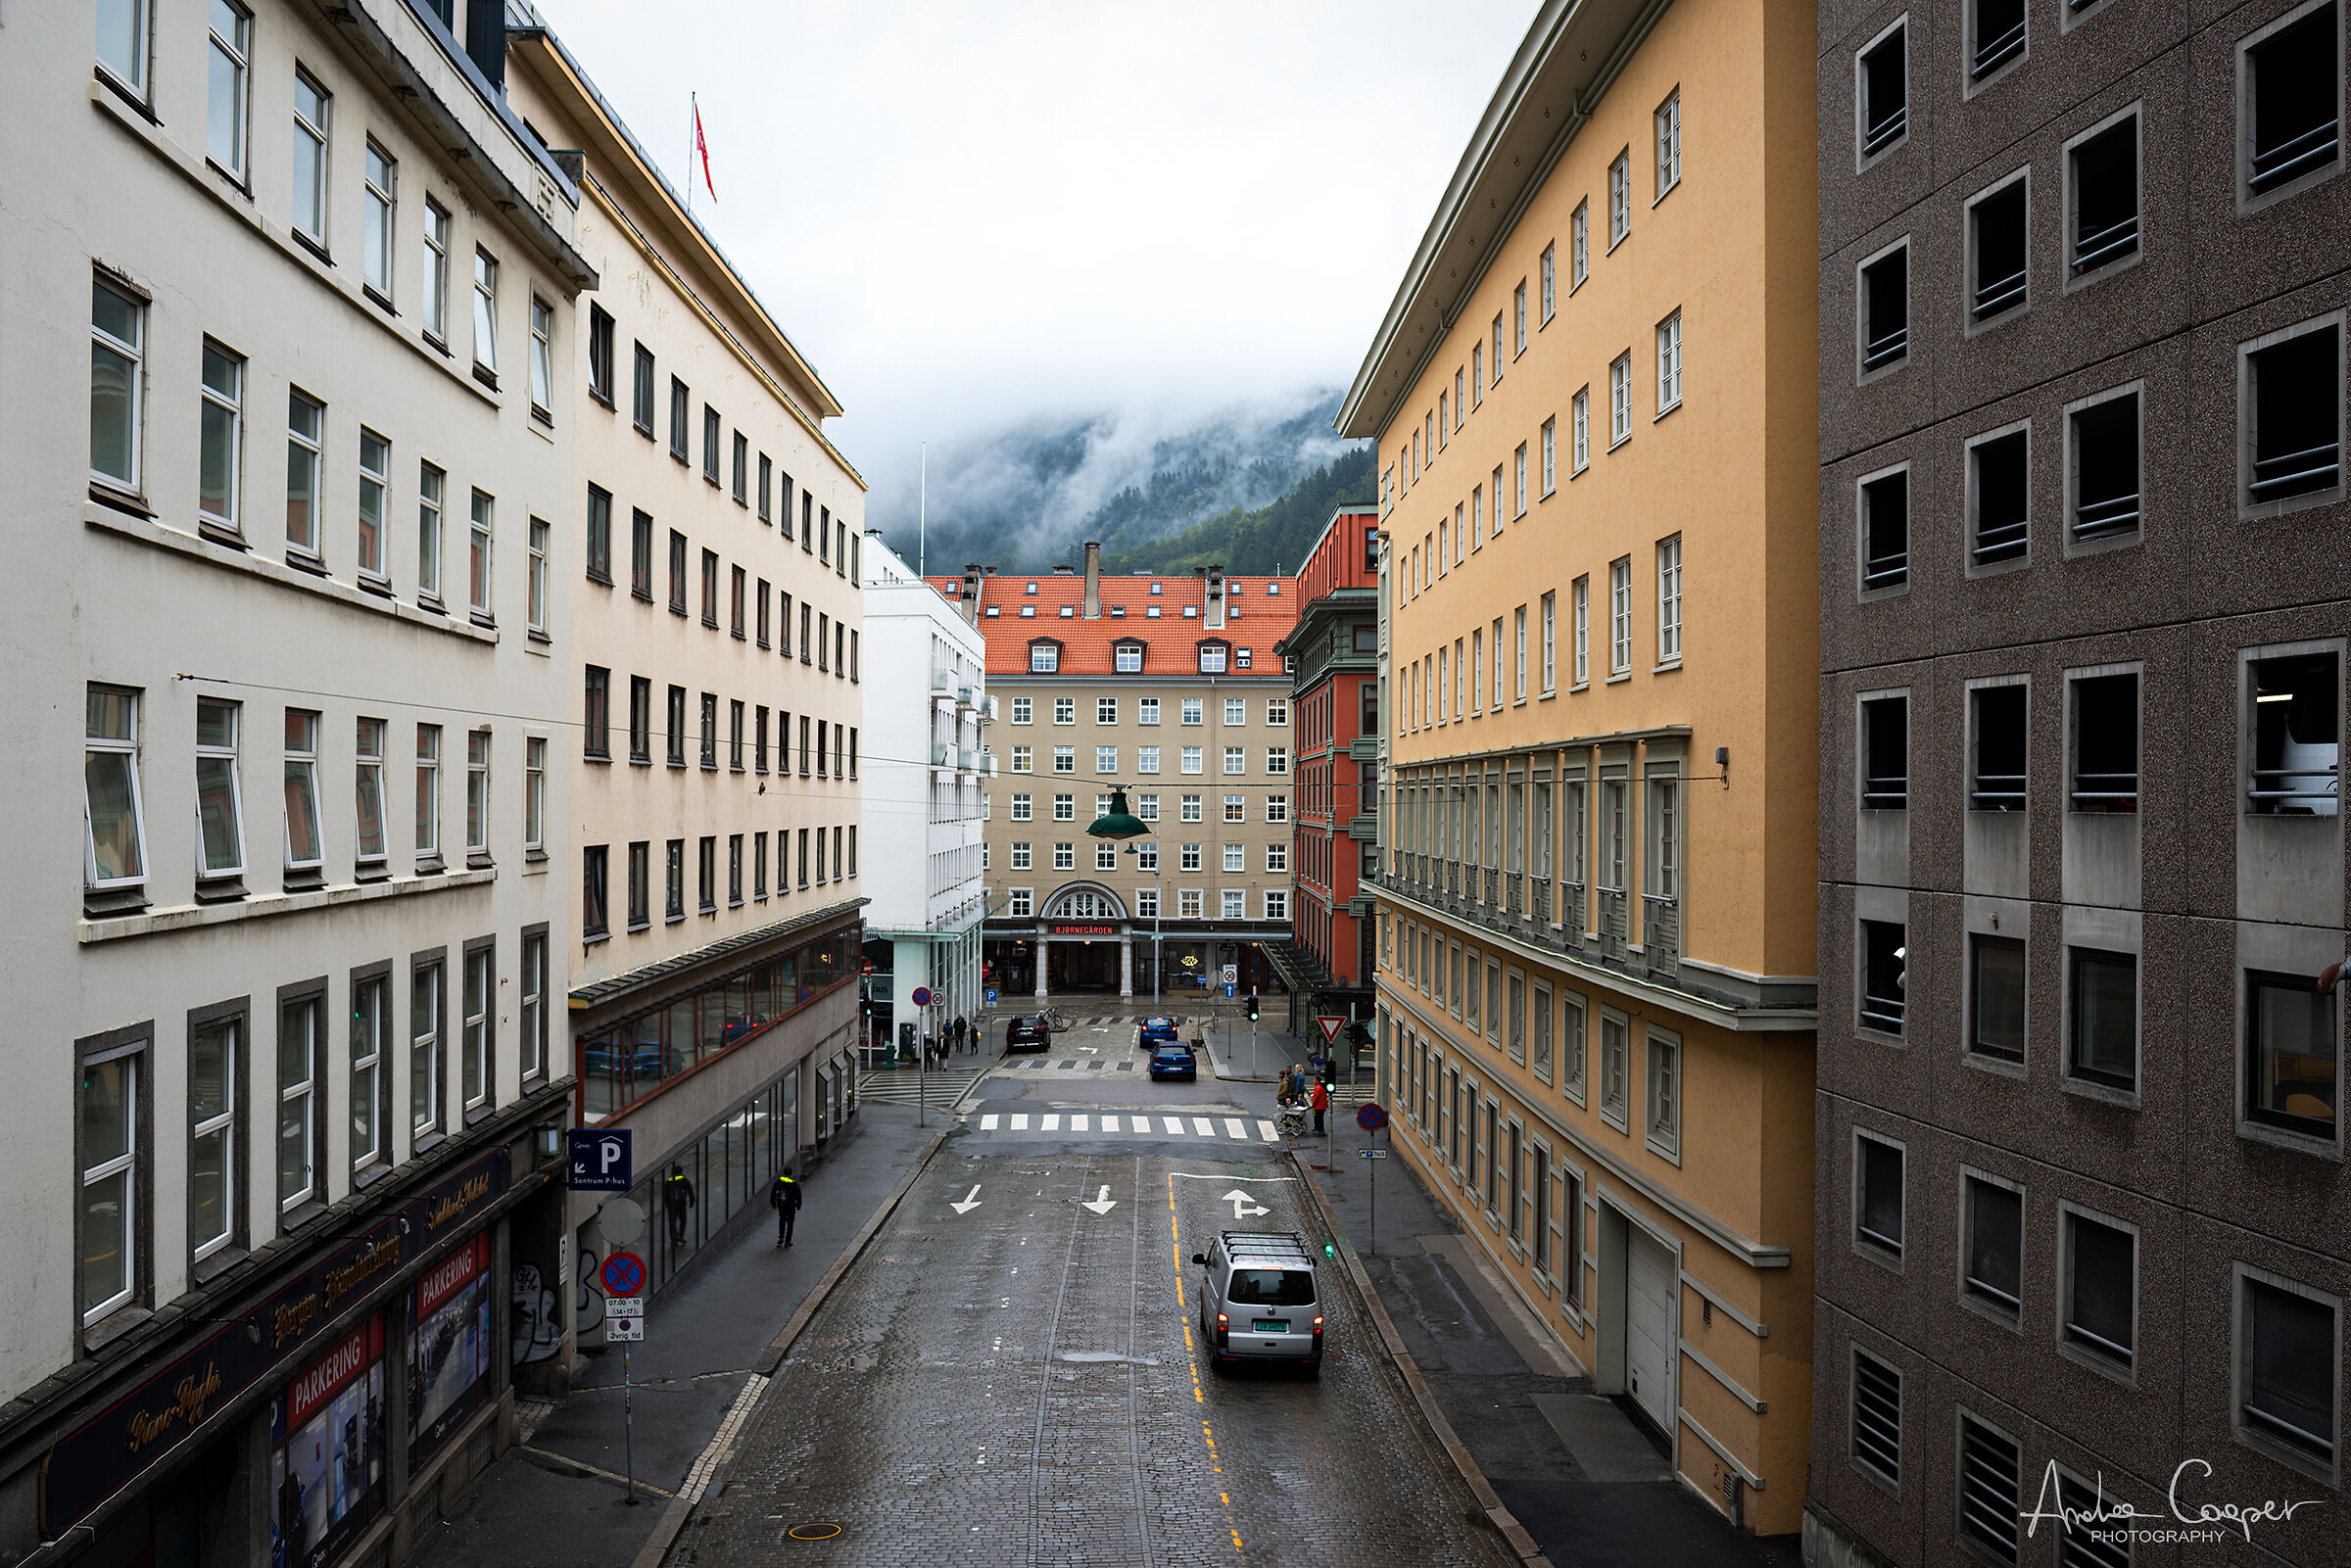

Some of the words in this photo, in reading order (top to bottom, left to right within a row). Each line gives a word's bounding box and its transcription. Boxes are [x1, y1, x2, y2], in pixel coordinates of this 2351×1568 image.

[1055, 925, 1113, 934] BJØRNEGÅRDEN
[987, 991, 995, 1000] P
[600, 1142, 621, 1174] P
[422, 1248, 472, 1307] PARKERING
[295, 1334, 361, 1414] PARKERING
